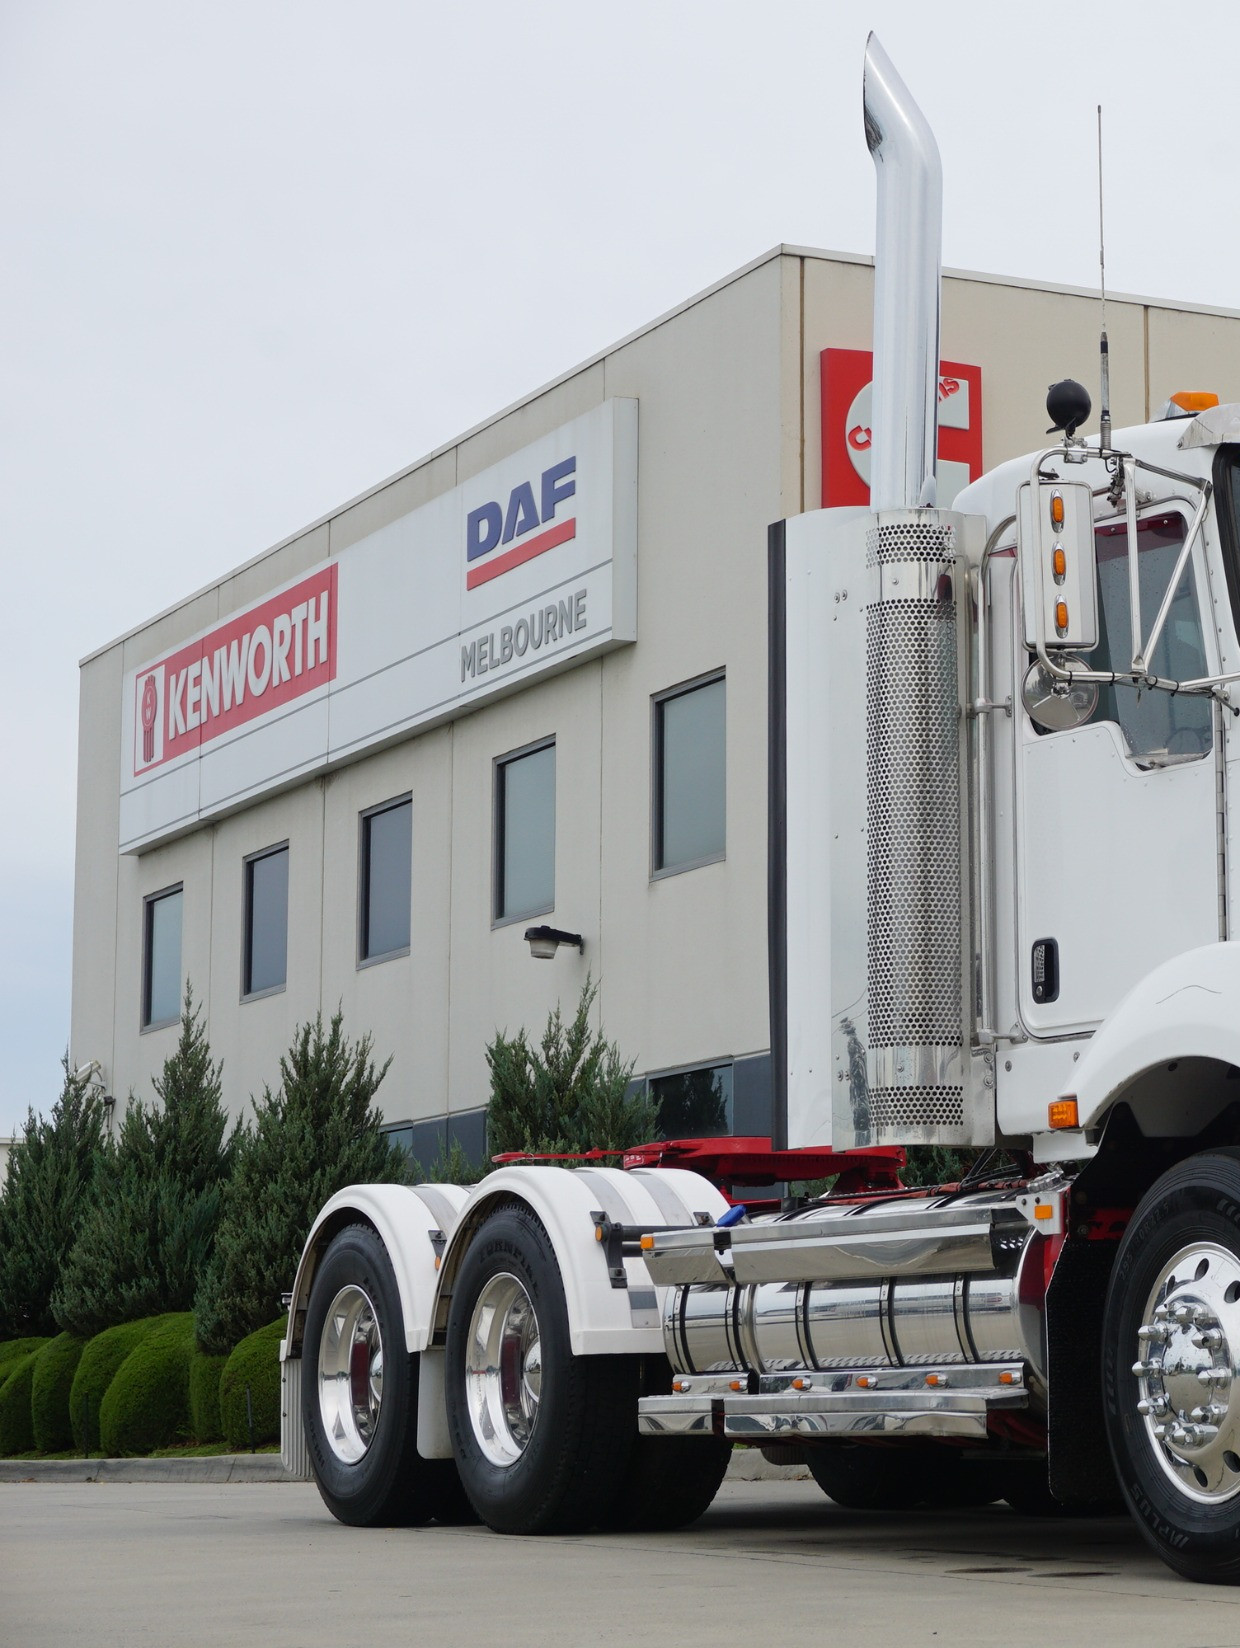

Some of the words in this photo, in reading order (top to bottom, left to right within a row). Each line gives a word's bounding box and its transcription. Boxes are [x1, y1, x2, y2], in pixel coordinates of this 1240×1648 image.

[467, 456, 576, 562] DAF
[168, 590, 329, 741] KENWORTH
[460, 589, 587, 682] MELBOURNE
